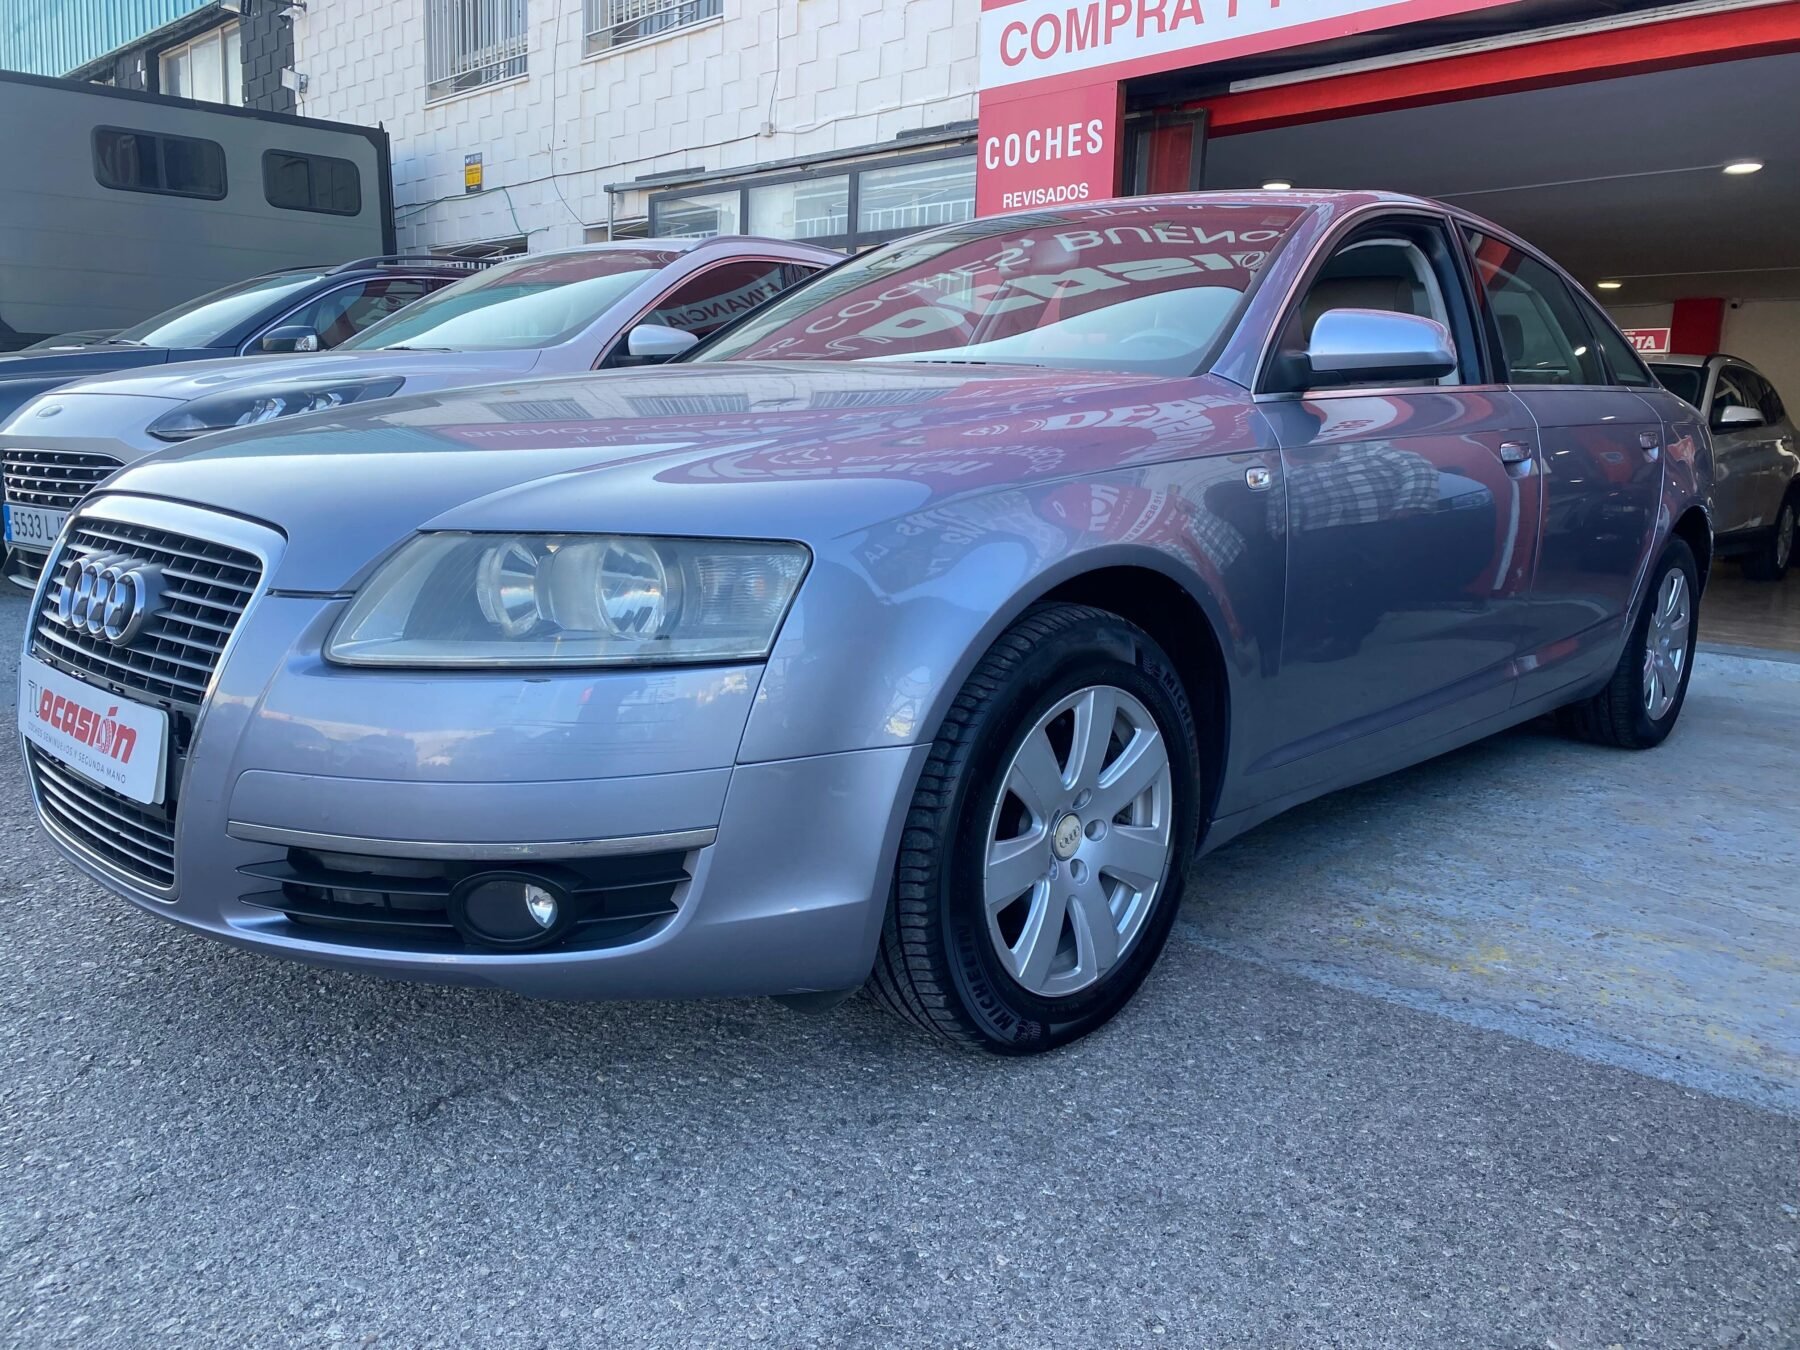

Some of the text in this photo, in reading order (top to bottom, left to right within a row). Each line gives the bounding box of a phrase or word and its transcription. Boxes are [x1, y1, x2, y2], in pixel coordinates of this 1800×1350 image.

[1000, 0, 1204, 67] COMPRA
[984, 119, 1104, 170] COCHES
[1002, 182, 1089, 209] REVISADOS
[13, 511, 42, 539] 5533
[78, 752, 105, 773] SEGUNDA
[105, 768, 127, 784] MANO
[959, 924, 1015, 1031] MICHELIN
